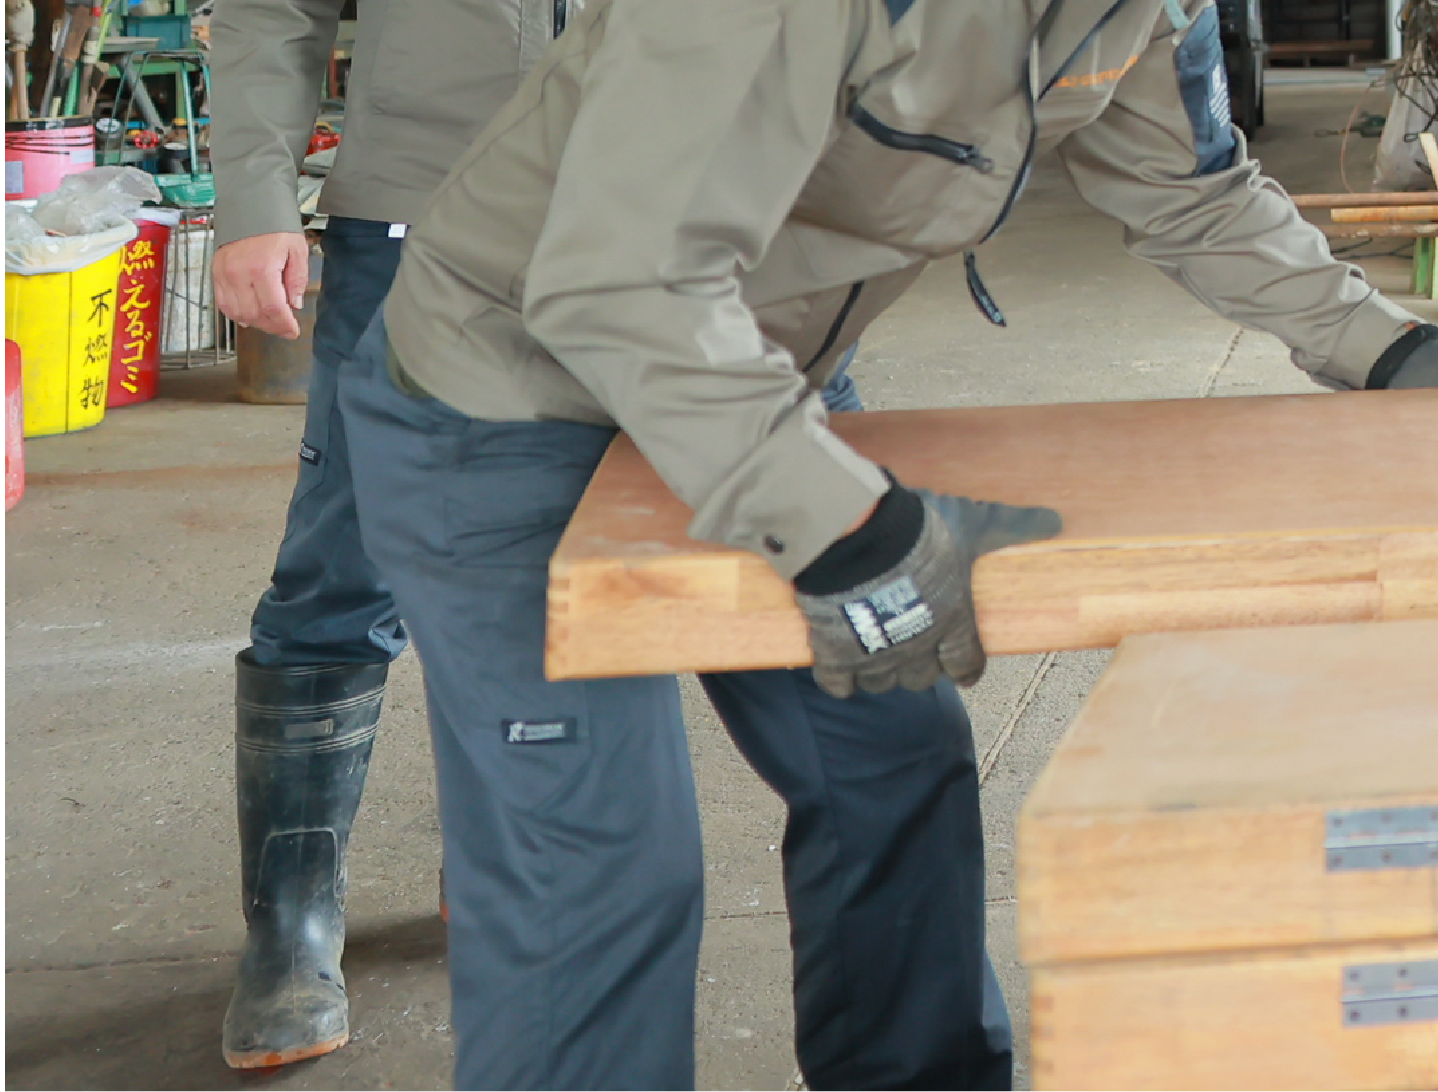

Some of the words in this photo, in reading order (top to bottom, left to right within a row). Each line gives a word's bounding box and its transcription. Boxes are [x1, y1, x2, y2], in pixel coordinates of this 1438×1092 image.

[78, 289, 112, 410] 不燃物
[119, 240, 155, 394] 燃えるゴミ
